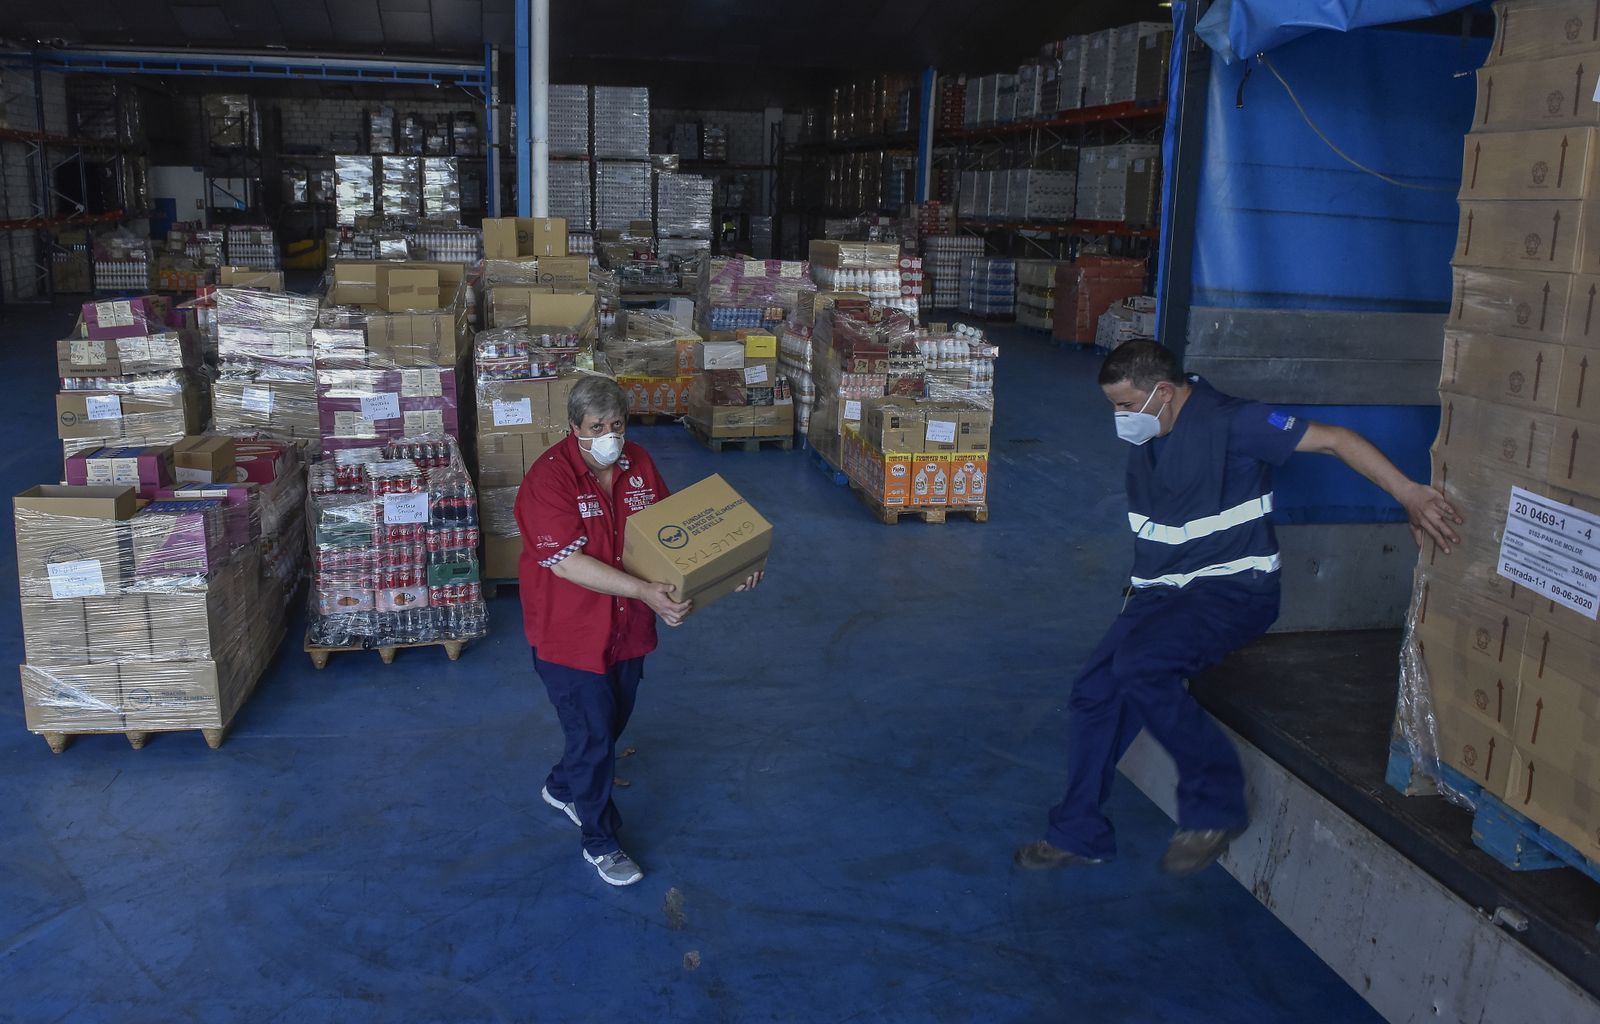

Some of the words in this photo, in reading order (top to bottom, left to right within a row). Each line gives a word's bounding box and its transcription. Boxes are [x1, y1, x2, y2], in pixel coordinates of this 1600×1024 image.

[682, 507, 715, 526] FUNDACIÓN
[687, 518, 706, 531] BANCO
[705, 514, 715, 523] DE
[1515, 502, 1527, 515] 20
[1530, 508, 1565, 530] 0469-1
[692, 527, 702, 536] DE
[701, 517, 724, 532] SEVILLA
[675, 520, 754, 570] GALLETAS
[1554, 539, 1562, 547] DE
[1562, 543, 1583, 556] MOLDE
[1504, 562, 1546, 589] Entrada-1-1
[1571, 566, 1597, 583] 325,000
[1551, 585, 1593, 609] 09-06-2020
